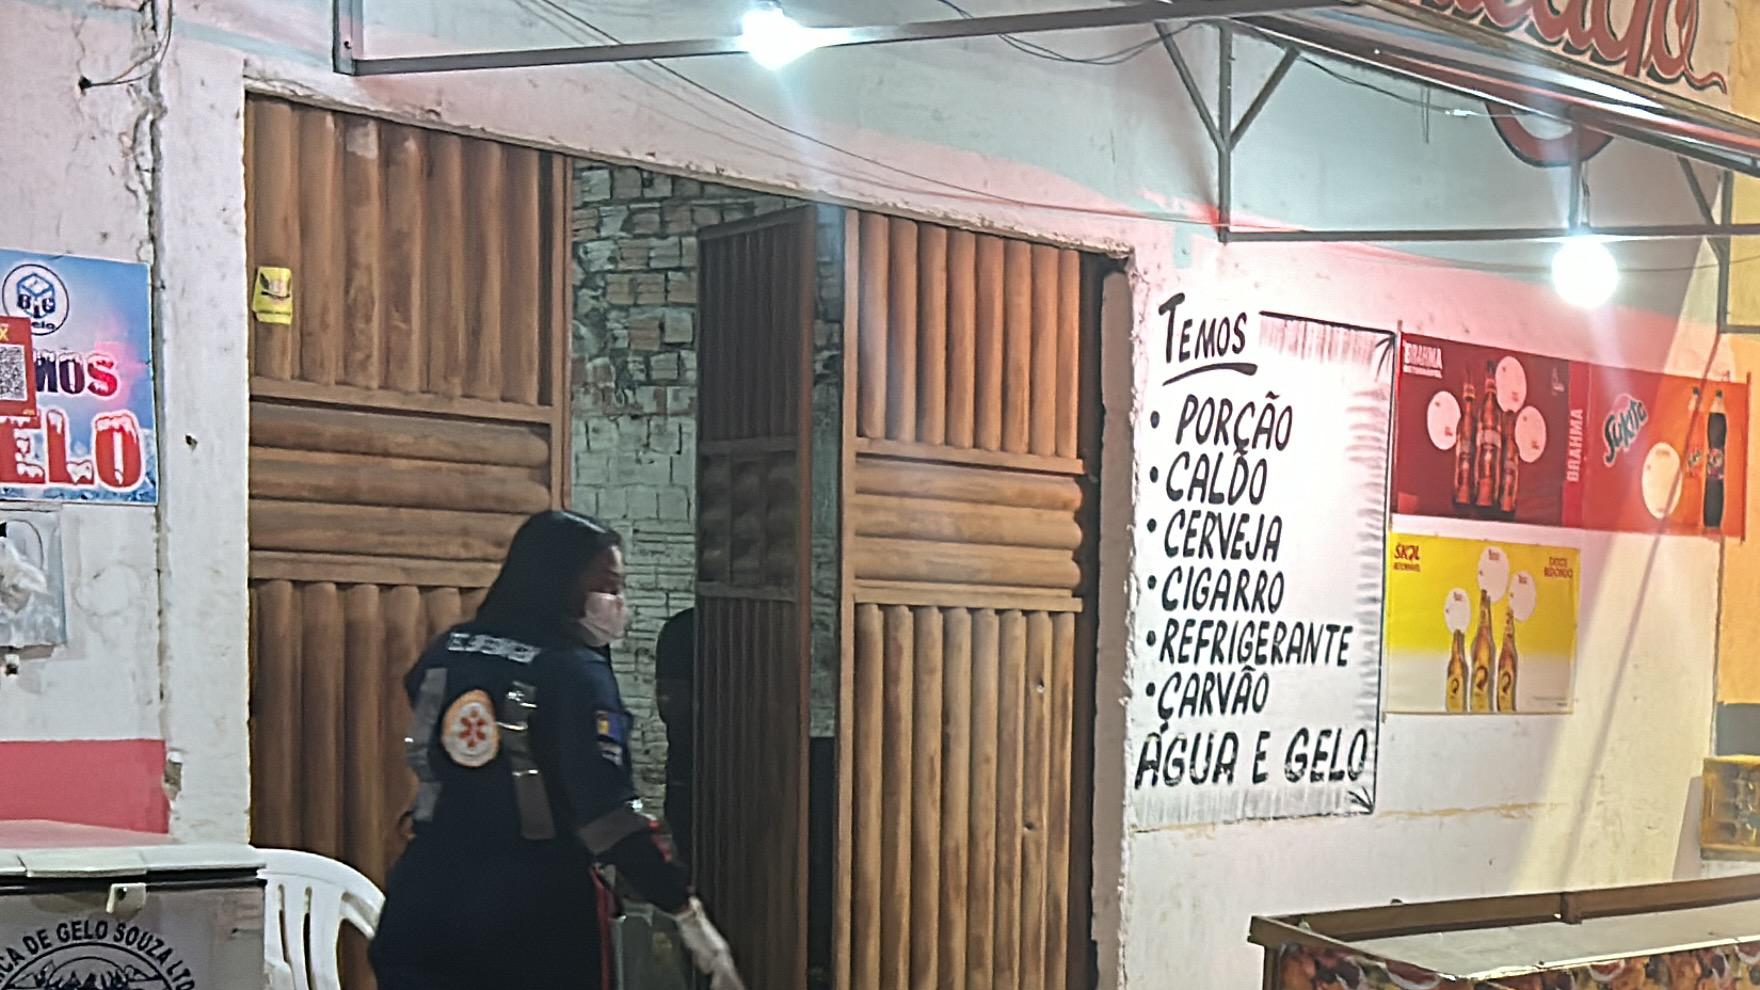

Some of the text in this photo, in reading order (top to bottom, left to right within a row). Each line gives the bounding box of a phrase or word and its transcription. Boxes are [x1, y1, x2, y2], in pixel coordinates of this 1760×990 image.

[31, 320, 57, 331] elo
[1158, 292, 1247, 364] TEMOS
[35, 350, 118, 398] MOS
[1175, 391, 1293, 455] PORÇÃO
[1165, 449, 1268, 505] CALDO
[1164, 508, 1282, 563] CERVEJA
[1161, 566, 1285, 614] CIGARRO
[1158, 617, 1353, 668] REFRIGERANTE
[1157, 664, 1269, 716] CARVÃO
[1135, 722, 1368, 790] ÁGUA E GELO
[22, 928, 52, 955] DE
[56, 920, 109, 943] GELO
[112, 922, 173, 967] SOUZA
